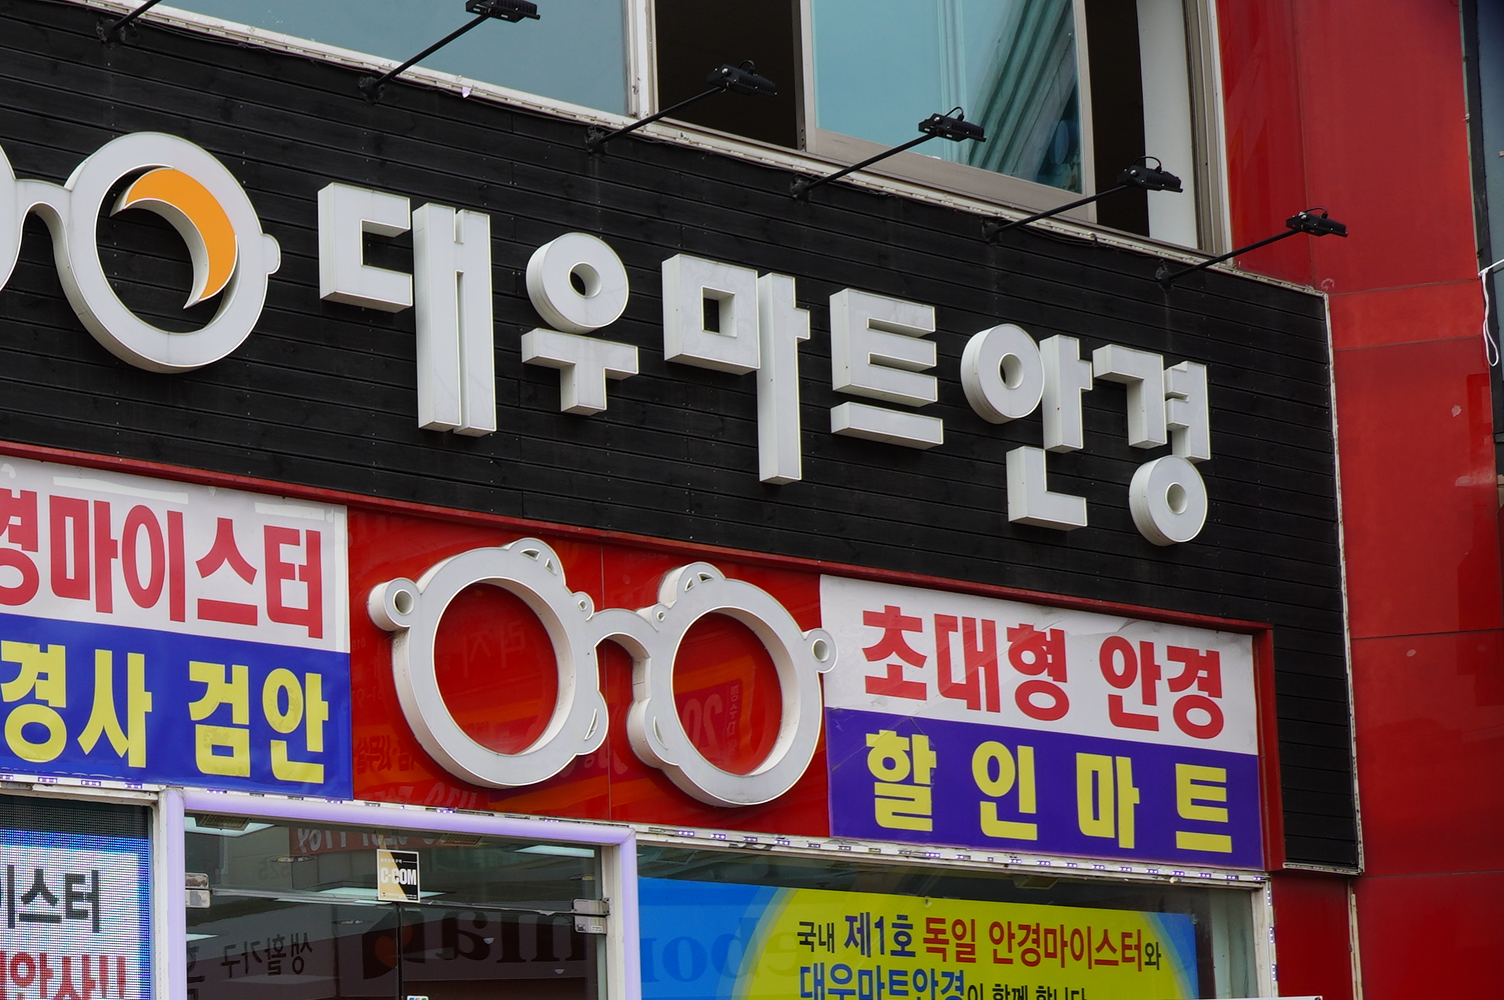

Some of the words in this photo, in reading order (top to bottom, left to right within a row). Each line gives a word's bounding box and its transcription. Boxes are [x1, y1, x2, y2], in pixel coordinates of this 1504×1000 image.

[317, 179, 1211, 550] 대우마트안경
[188, 660, 329, 784] 검안
[862, 604, 1070, 722] 초대형
[1099, 635, 1224, 740] 안경
[797, 920, 835, 953] 국내
[843, 911, 916, 958] 제1호
[923, 917, 976, 963] 독일
[988, 921, 1161, 971] 안경마이스터와
